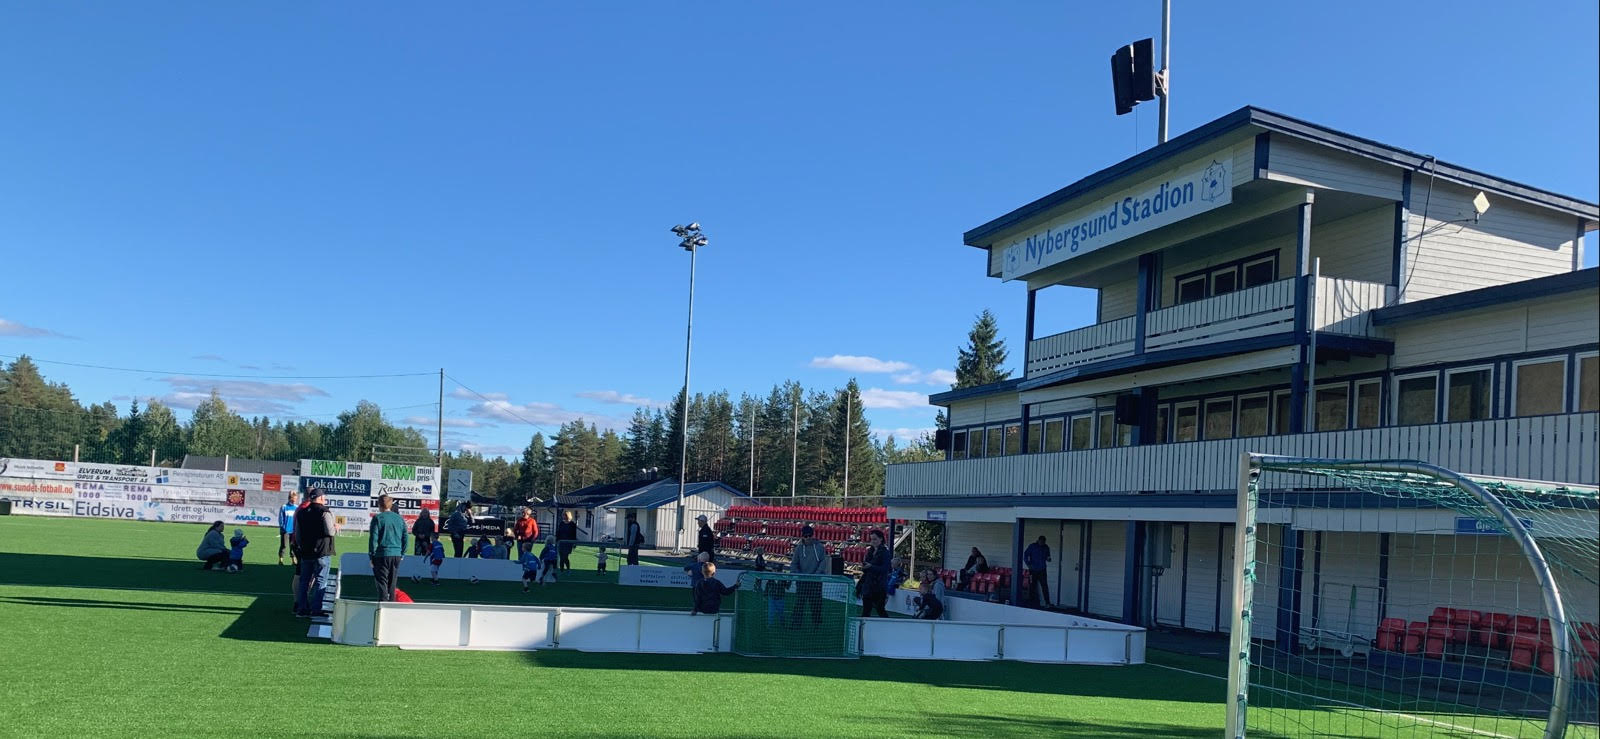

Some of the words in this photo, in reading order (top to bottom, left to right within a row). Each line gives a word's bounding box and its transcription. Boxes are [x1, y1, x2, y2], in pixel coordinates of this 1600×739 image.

[1025, 202, 1119, 264] Nybergsund
[1121, 181, 1194, 226] Stadion
[78, 467, 111, 475] ELVERUM
[311, 460, 346, 477] KIWI
[347, 463, 363, 471] mini
[382, 464, 416, 480] KIWI
[417, 467, 432, 475] mini
[75, 482, 104, 491] REMA
[123, 485, 152, 493] REMA
[305, 479, 366, 491] Lokalavisa
[78, 491, 101, 499] 1000
[126, 493, 149, 501] 1000
[12, 499, 70, 510] TRYSIL
[75, 501, 134, 518] Eidsiva
[203, 505, 224, 513] kultur
